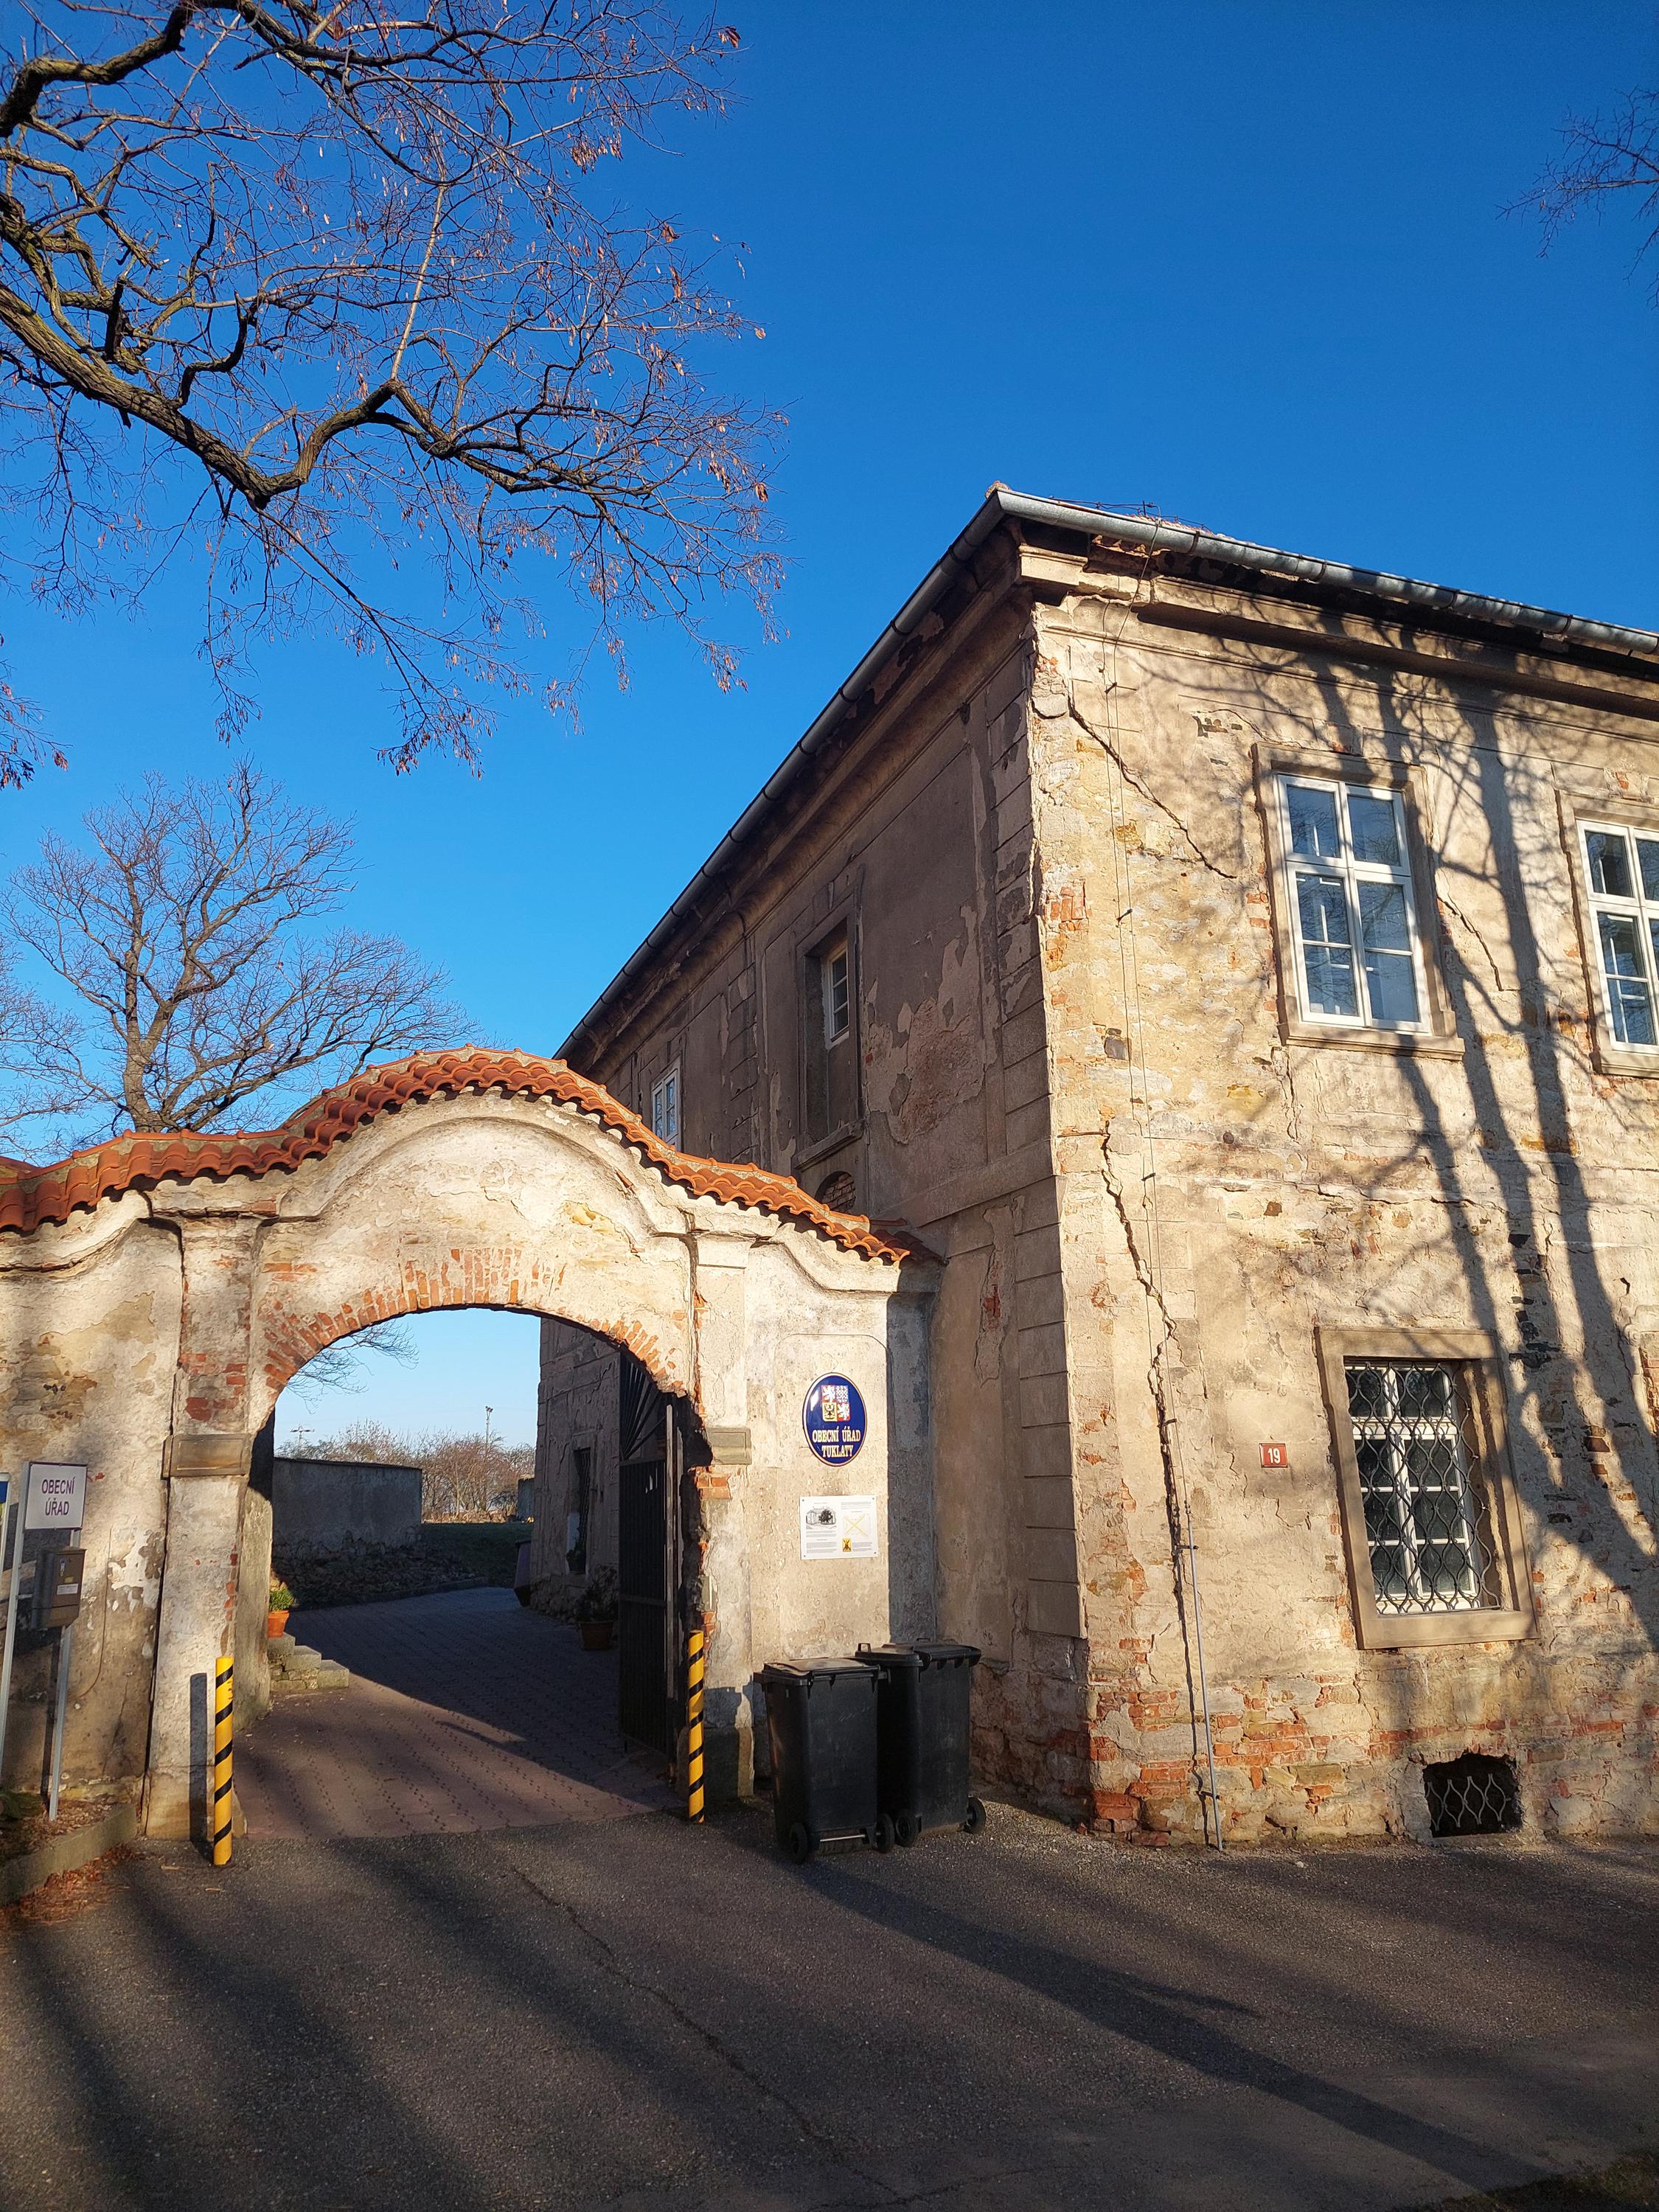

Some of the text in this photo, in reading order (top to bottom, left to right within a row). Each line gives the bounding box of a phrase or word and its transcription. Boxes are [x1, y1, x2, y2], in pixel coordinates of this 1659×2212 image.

[812, 1425, 861, 1443] OBECNÍ ÚŘAD
[821, 1444, 854, 1458] TUKLATY
[1267, 1447, 1281, 1464] 19
[41, 1477, 76, 1495] OBECNÍ
[45, 1498, 69, 1516] ÚŘAD
